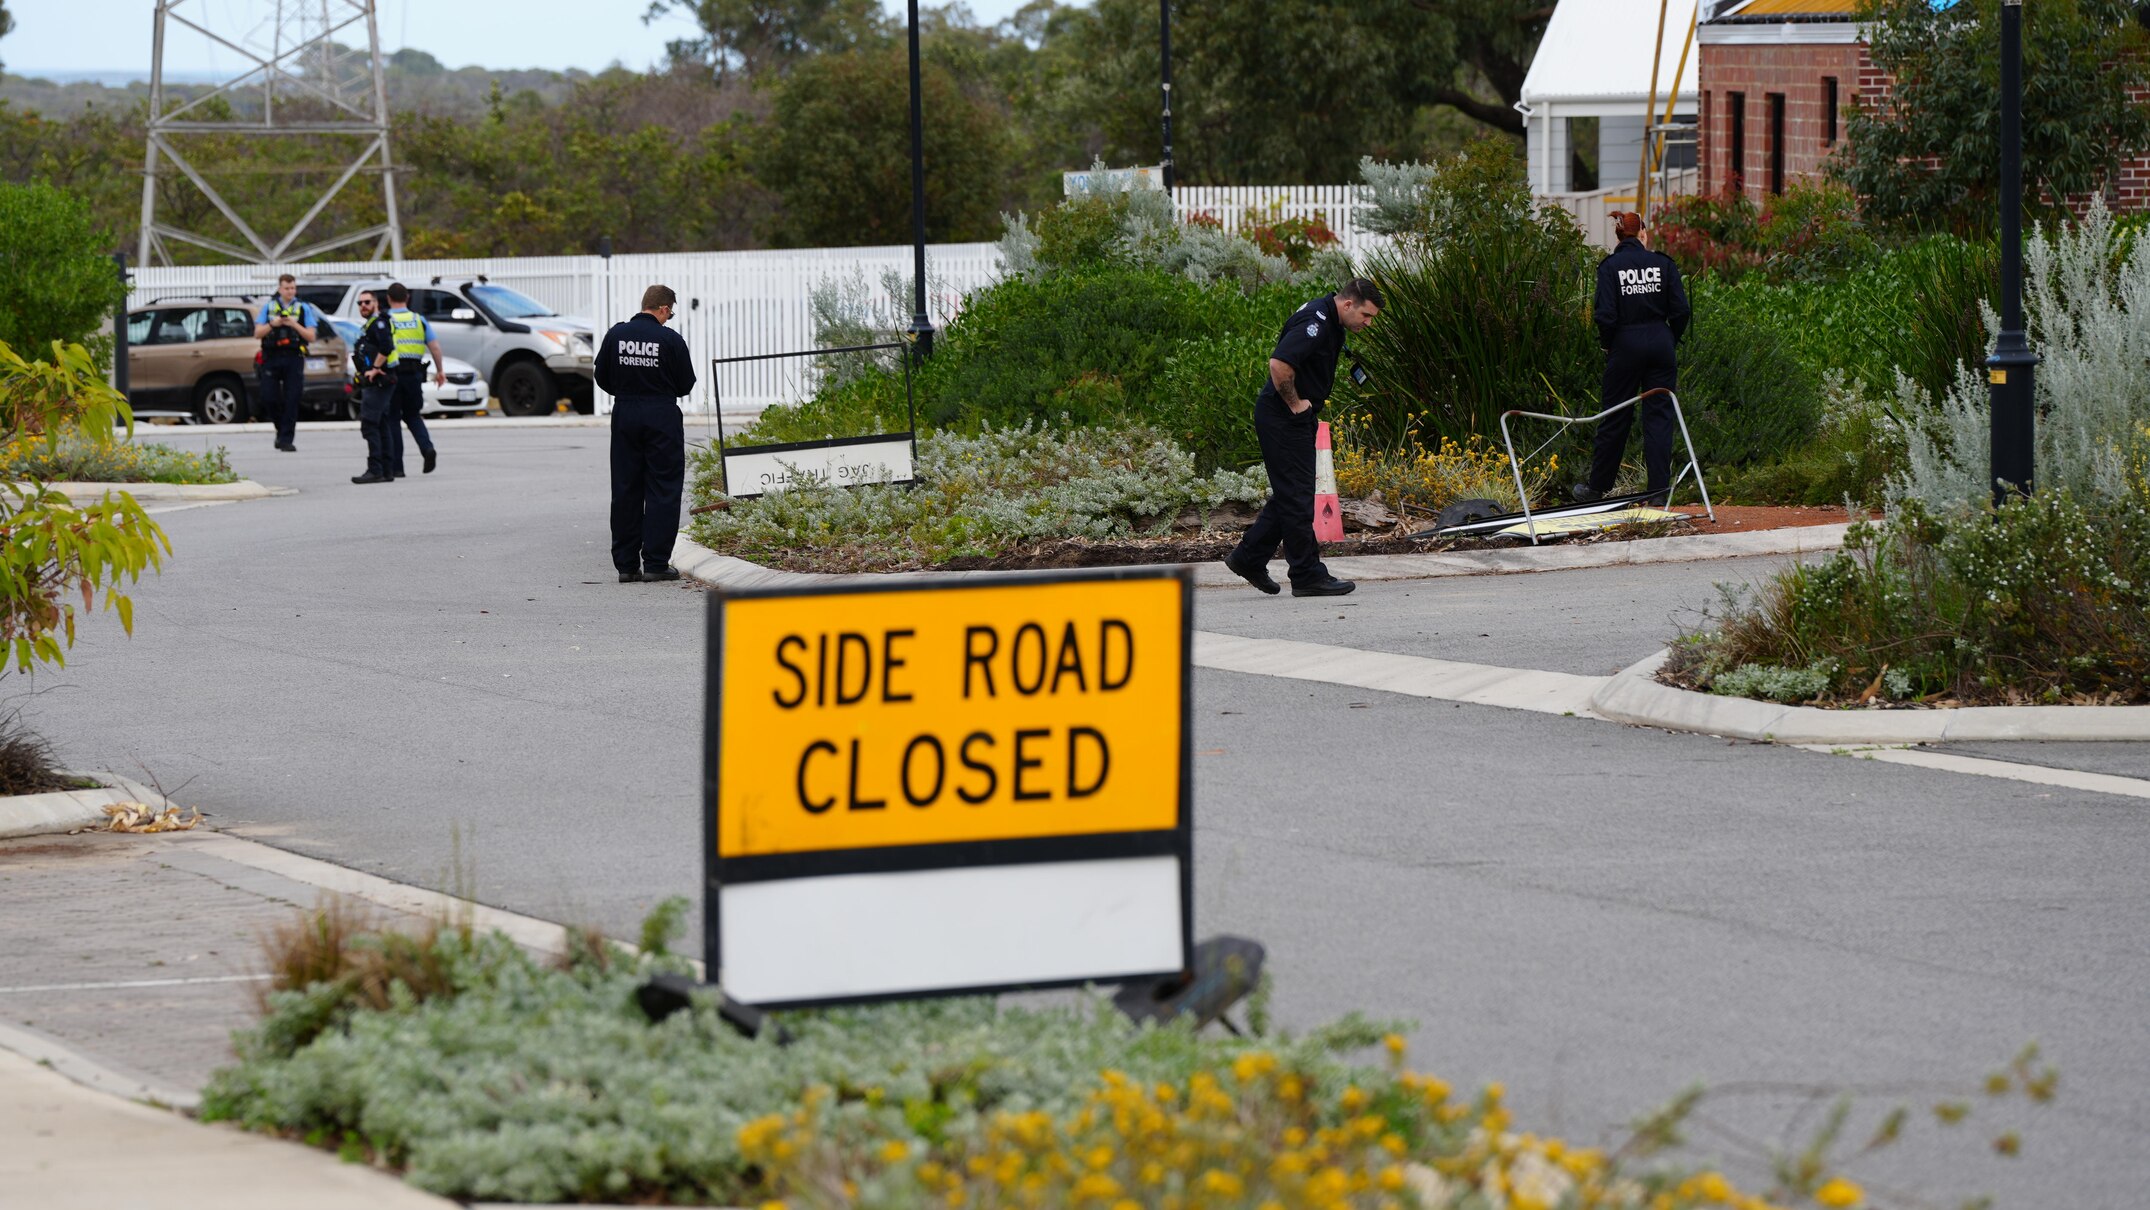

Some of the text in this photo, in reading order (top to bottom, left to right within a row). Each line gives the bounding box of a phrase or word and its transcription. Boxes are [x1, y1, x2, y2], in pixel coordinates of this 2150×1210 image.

[1618, 267, 1661, 285] POLICE
[1621, 283, 1661, 296] FORENSIC
[619, 340, 659, 356] POLICE
[619, 356, 659, 367] FORENSIC
[838, 464, 869, 479] JAG
[772, 619, 1134, 709] SIDE ROAD
[797, 726, 1111, 815] CLOSED
